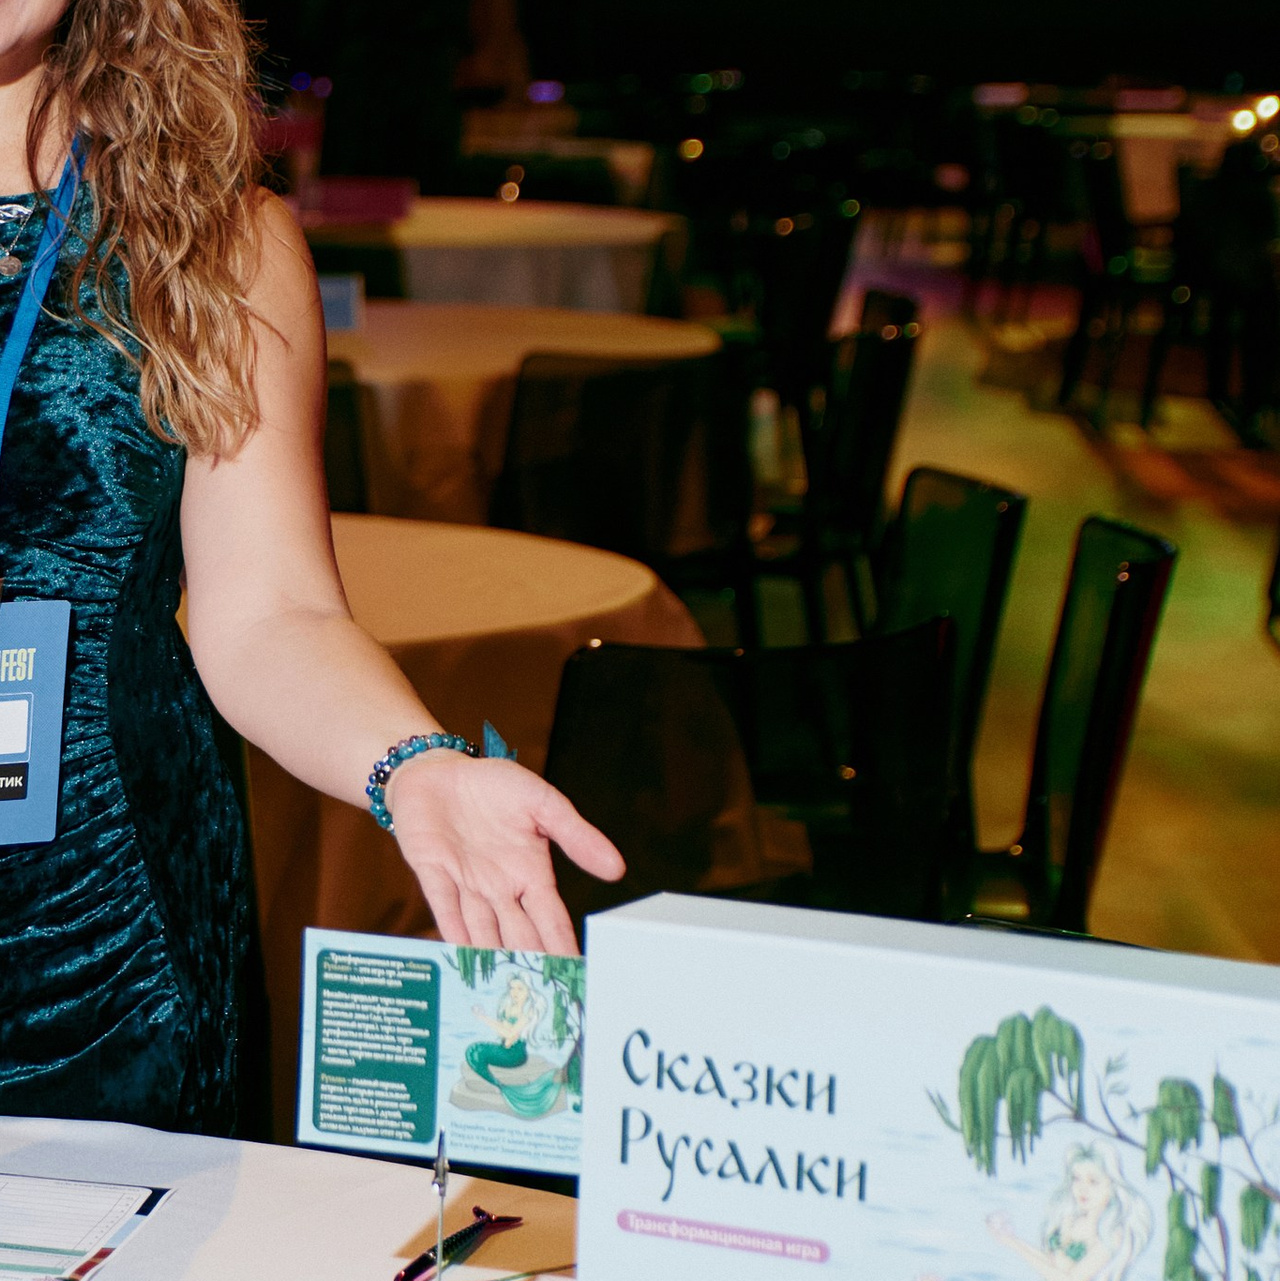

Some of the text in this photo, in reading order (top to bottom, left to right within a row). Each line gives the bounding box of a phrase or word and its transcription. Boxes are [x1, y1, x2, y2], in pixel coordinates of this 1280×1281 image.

[0, 647, 37, 683] FEST
[621, 1028, 837, 1115] Сказки
[619, 1106, 868, 1203] Русалки
